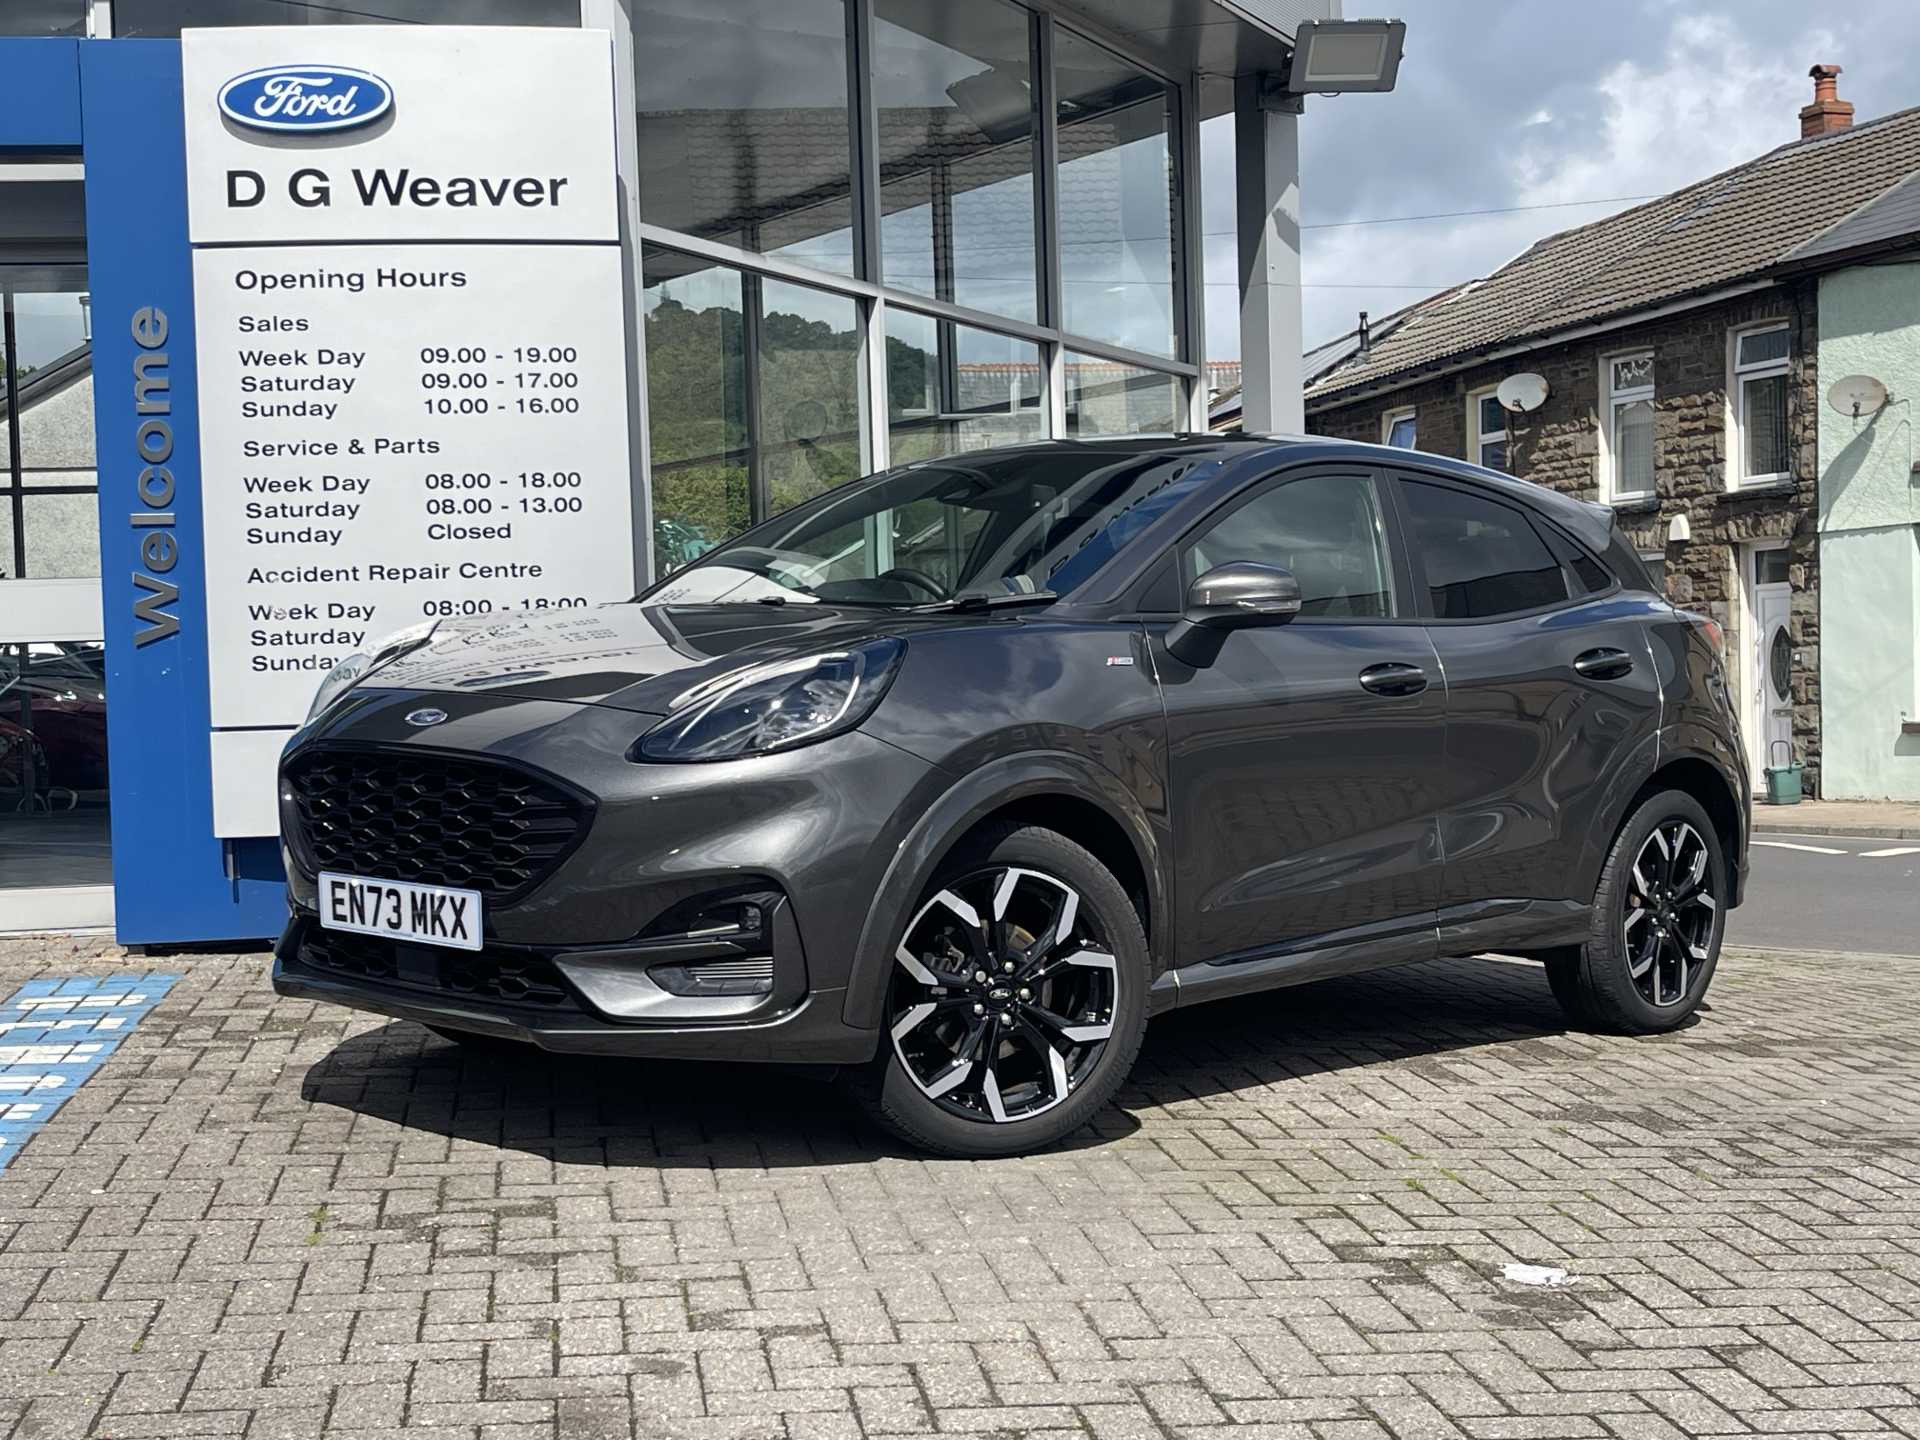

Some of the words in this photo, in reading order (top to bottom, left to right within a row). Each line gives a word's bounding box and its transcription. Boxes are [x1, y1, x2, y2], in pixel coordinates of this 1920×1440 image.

[254, 76, 357, 117] Ford
[226, 170, 266, 208] D
[287, 168, 332, 208] G
[351, 168, 569, 208] Weaver
[235, 269, 365, 293] Opening
[376, 268, 467, 288] Hours
[238, 316, 310, 332] Sales
[238, 350, 308, 367] Week
[317, 349, 367, 369] Day
[420, 347, 487, 364] 09.00
[513, 347, 577, 363] 19.00
[240, 375, 356, 393] Saturday
[421, 373, 488, 389] 09.00
[514, 372, 579, 389] 17.00
[242, 401, 339, 419] Sunday
[423, 398, 489, 414] 10.00
[516, 397, 580, 414] 16.00
[243, 440, 339, 457] Service
[348, 438, 365, 455] &
[374, 438, 441, 455] Parts
[130, 306, 181, 649] Welcome
[243, 476, 314, 493] Week
[322, 475, 371, 495] Day
[425, 473, 492, 490] 08.00
[517, 472, 582, 488] 18.00
[245, 501, 361, 520] Saturday
[426, 498, 493, 515] 08.00
[519, 497, 583, 513] 13.00
[246, 527, 343, 546] Sunday
[427, 523, 512, 540] Closed
[247, 566, 361, 584] Accident
[368, 564, 451, 583] Repair
[458, 562, 543, 578] Centre
[248, 604, 319, 621] Week
[327, 603, 376, 622] Day
[423, 599, 492, 616] 08:00
[250, 628, 366, 647] Saturday
[330, 880, 402, 930] EN73
[410, 890, 468, 940] MKX
